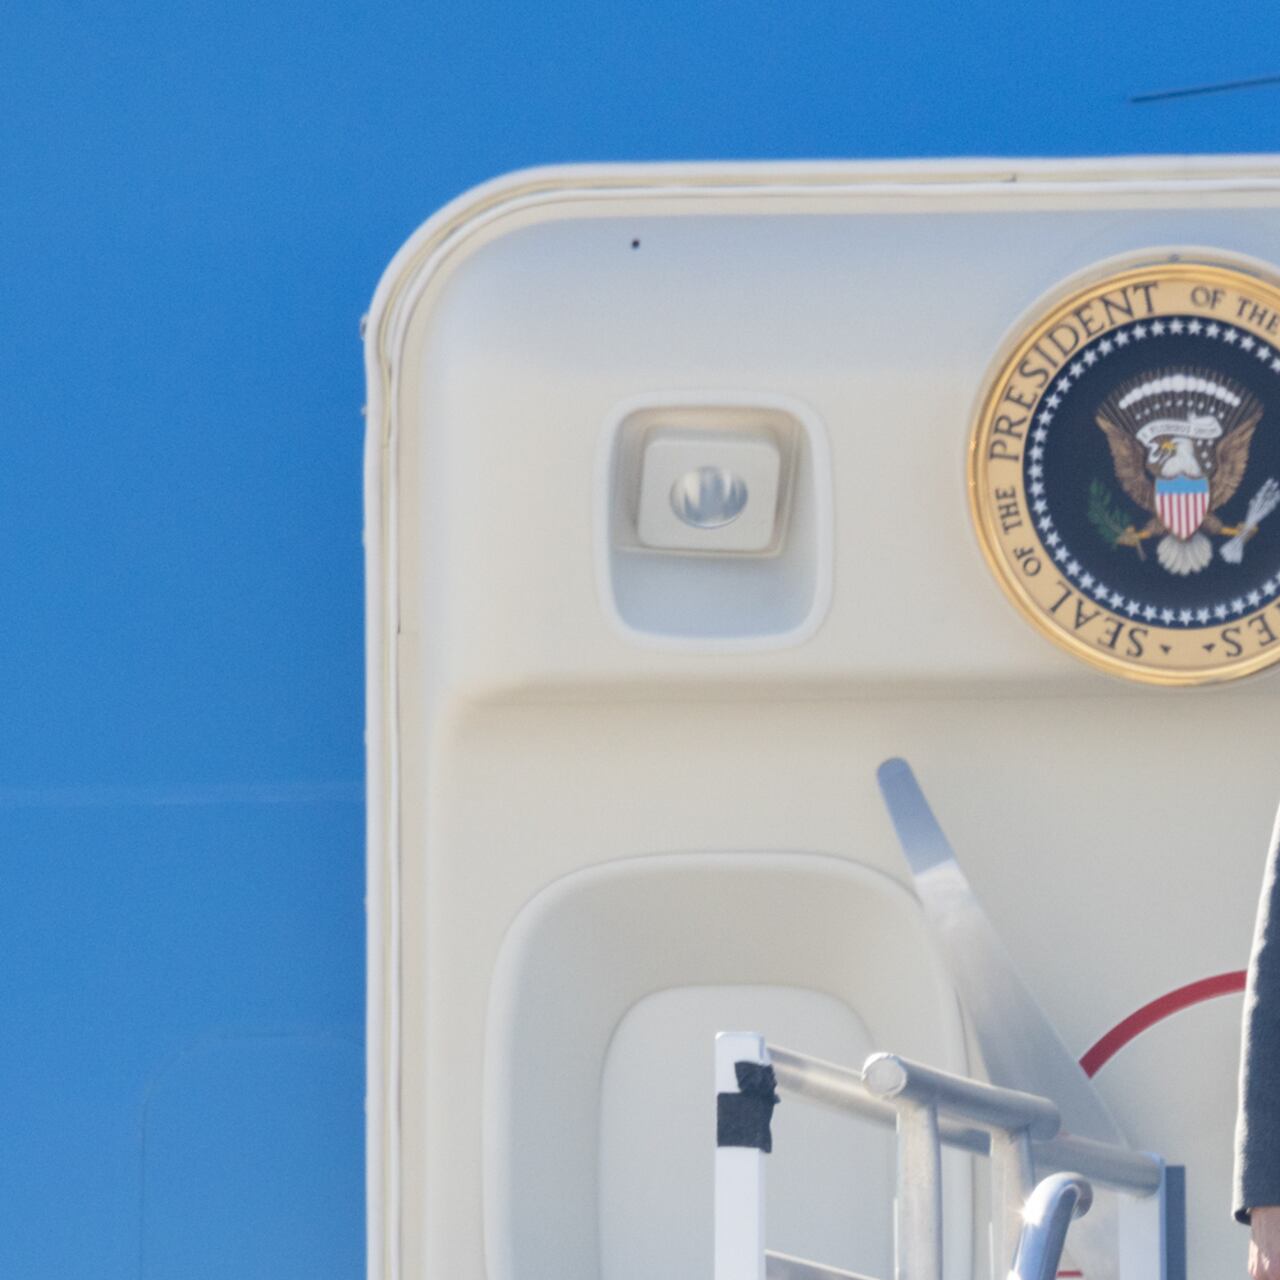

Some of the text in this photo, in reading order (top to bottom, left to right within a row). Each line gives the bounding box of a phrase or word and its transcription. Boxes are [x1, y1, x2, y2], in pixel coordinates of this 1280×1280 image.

[1190, 286, 1225, 309] OF
[990, 282, 1158, 462] PRESIDENT
[994, 486, 1022, 535] THE
[1013, 546, 1042, 578] OF
[1050, 580, 1149, 658] SEAL
